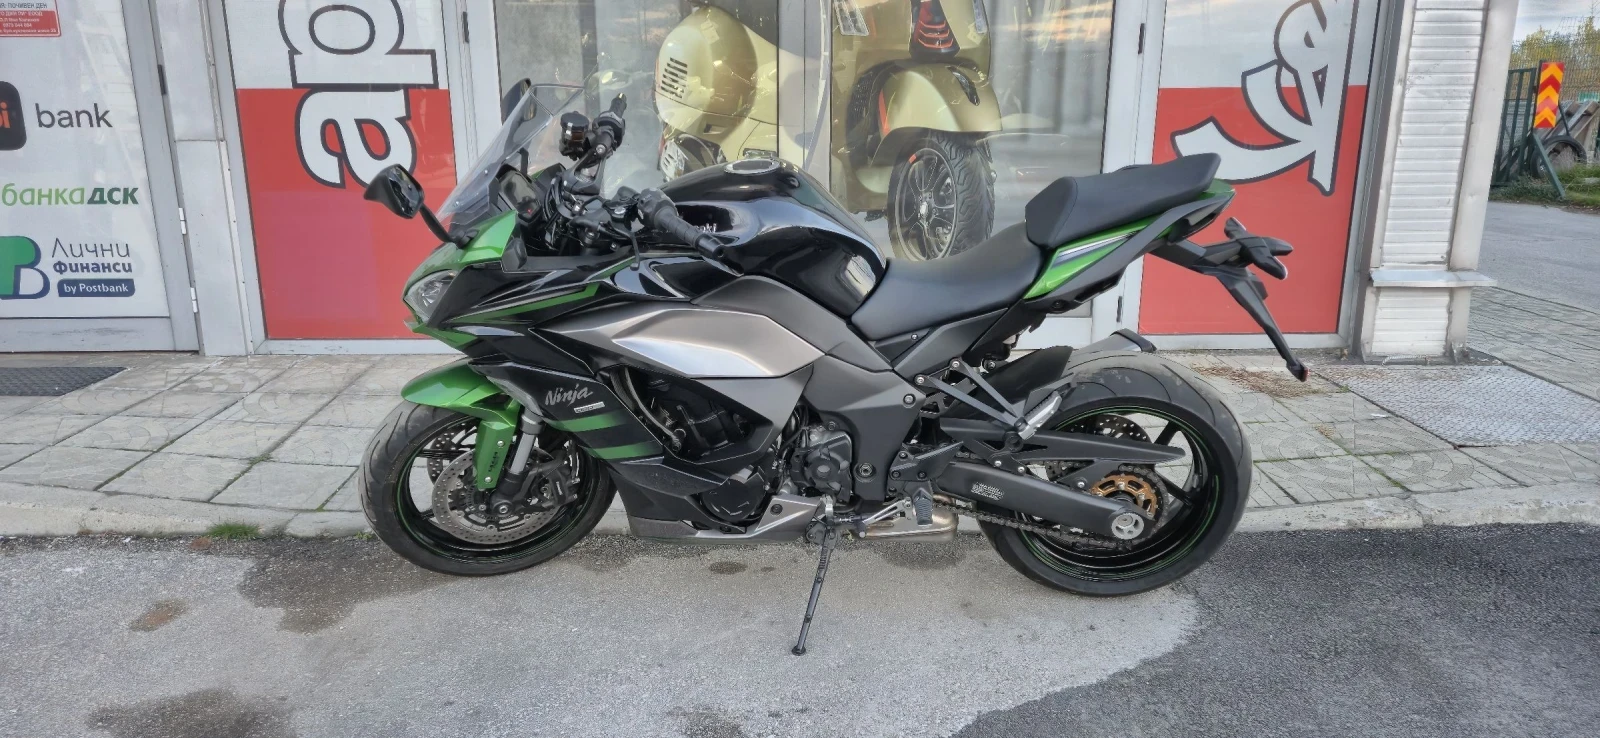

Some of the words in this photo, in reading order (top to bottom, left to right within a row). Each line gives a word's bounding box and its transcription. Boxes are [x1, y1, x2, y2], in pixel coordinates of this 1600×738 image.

[35, 103, 113, 129] bank
[52, 238, 130, 258] Лични
[53, 260, 133, 275] финанси
[64, 284, 76, 294] by
[79, 283, 128, 293] Postbank
[545, 383, 593, 407] Ninja
